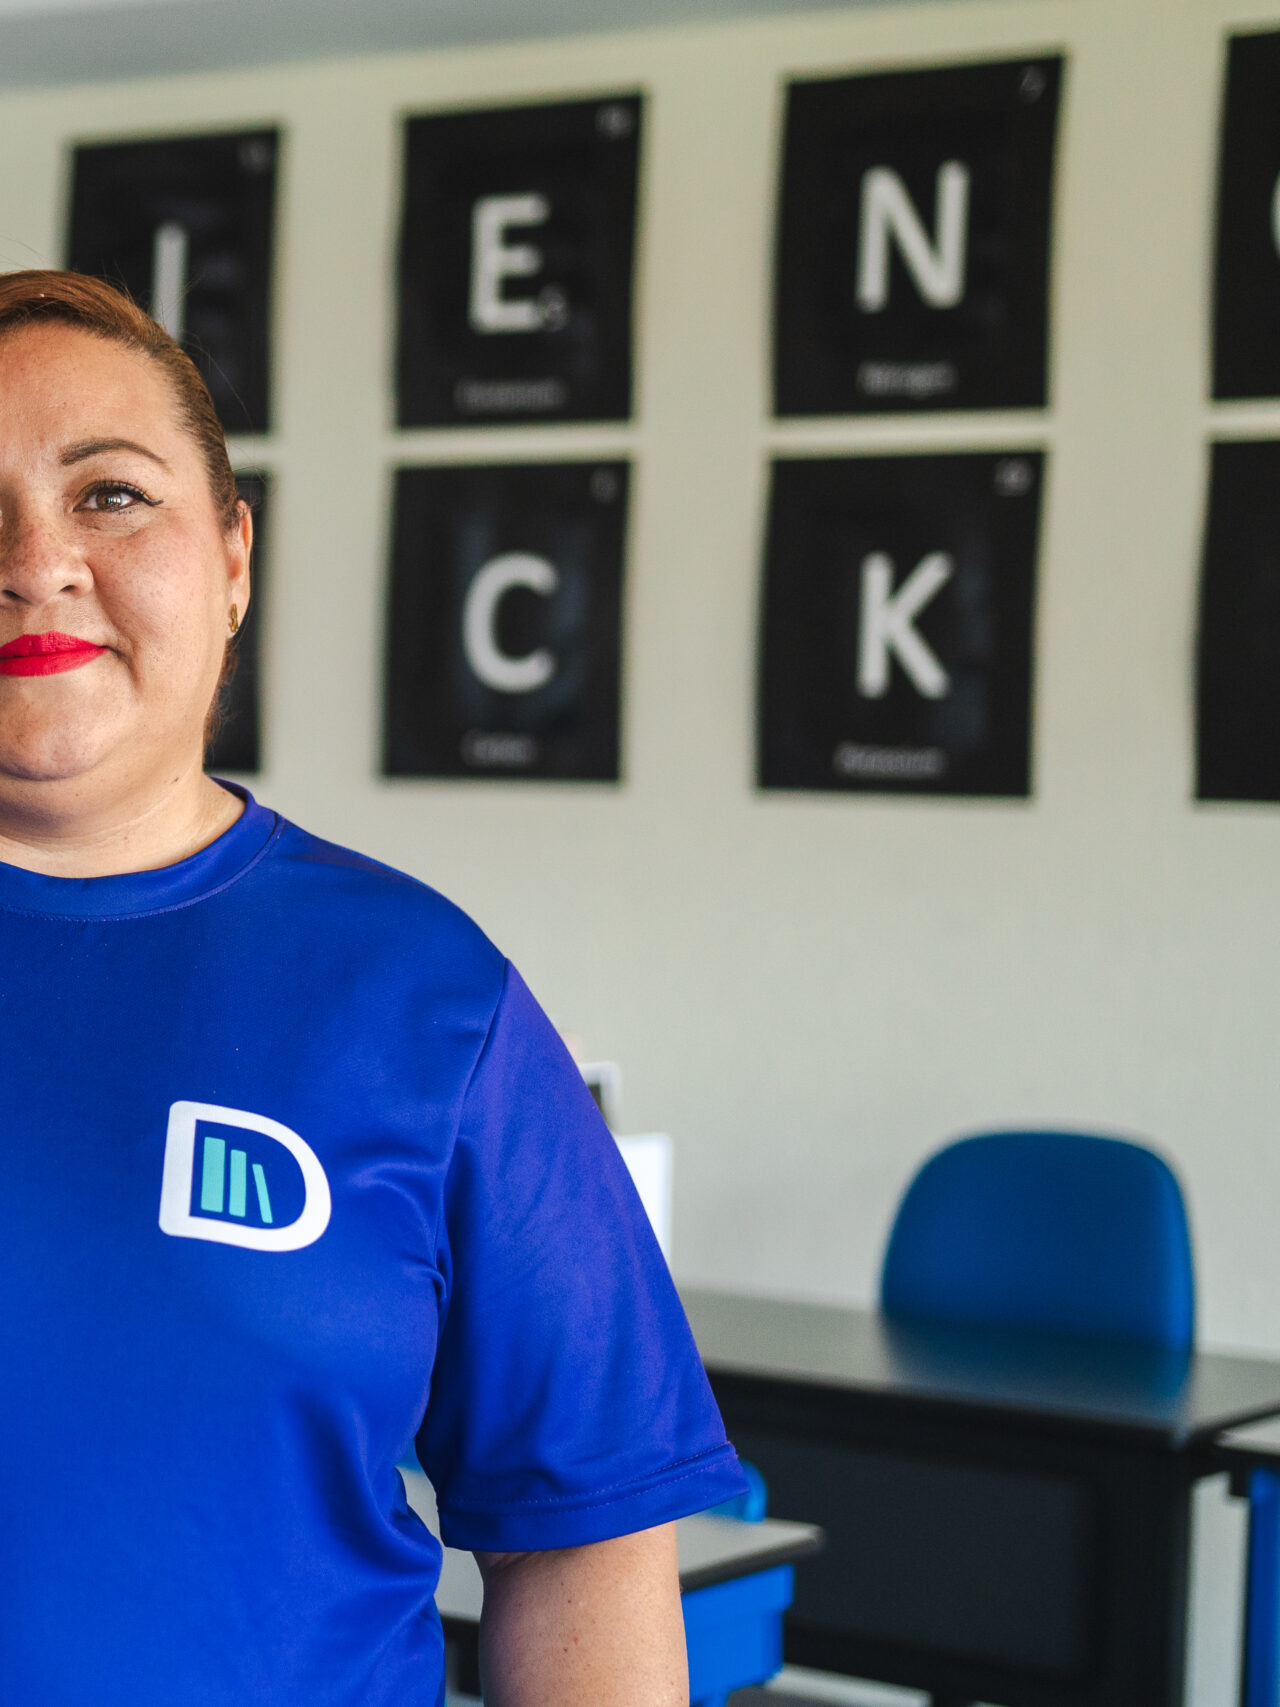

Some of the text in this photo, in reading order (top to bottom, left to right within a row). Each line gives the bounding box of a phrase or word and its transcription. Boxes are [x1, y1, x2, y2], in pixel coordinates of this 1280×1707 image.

[856, 160, 970, 312] N
[463, 551, 558, 693] C
[858, 551, 952, 698] K
